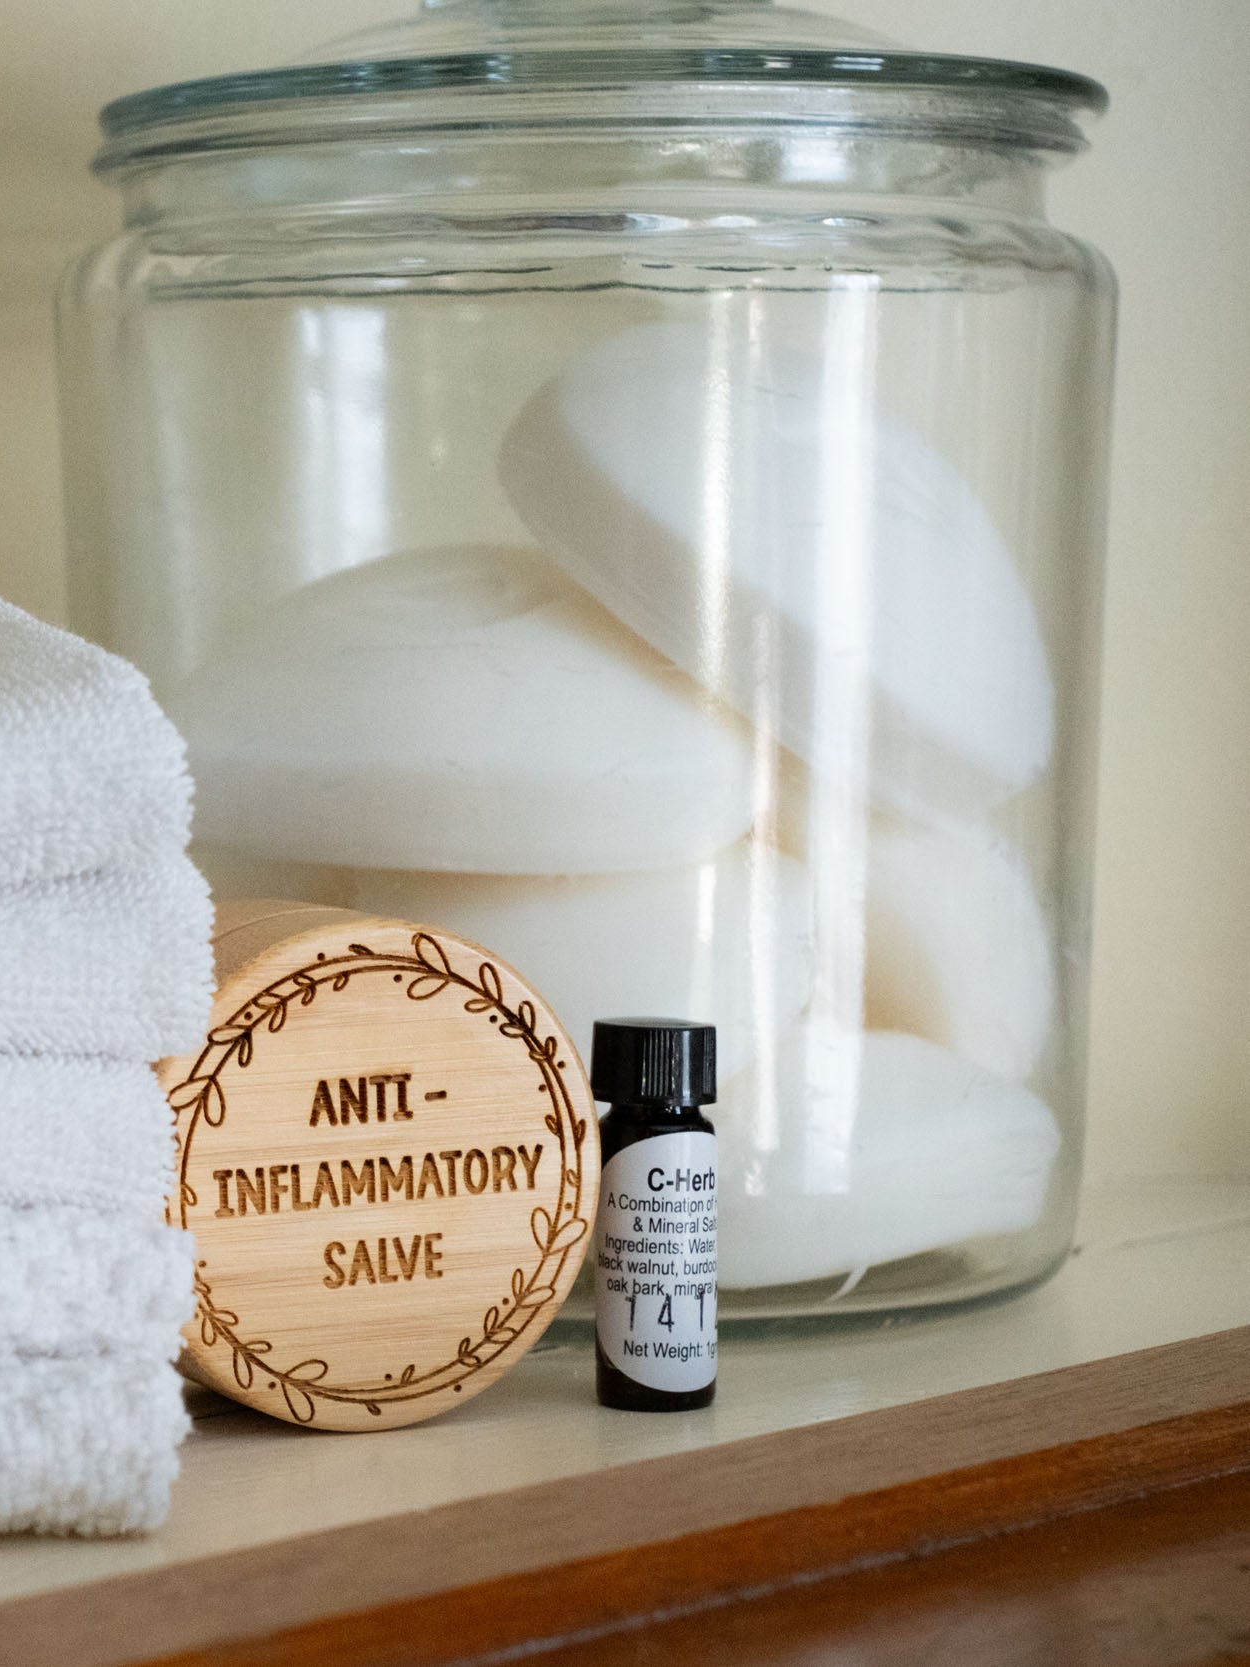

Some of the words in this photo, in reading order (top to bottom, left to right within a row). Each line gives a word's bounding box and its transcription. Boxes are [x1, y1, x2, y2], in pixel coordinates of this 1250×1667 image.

[309, 1073, 414, 1127] ANTI
[213, 1143, 544, 1218] INFLAMMATORY
[647, 1166, 716, 1192] C-Herb
[607, 1191, 616, 1208] A
[618, 1193, 704, 1213] Combination
[706, 1195, 714, 1211] of
[633, 1216, 643, 1232] &
[649, 1217, 699, 1234] Mineral
[605, 1233, 684, 1255] Ingredients:
[322, 1232, 444, 1289] SALVE
[598, 1250, 623, 1272] black
[627, 1259, 678, 1278] walnut,
[607, 1277, 628, 1293] oak
[674, 1280, 714, 1296] mineral
[624, 1339, 648, 1357] Net
[653, 1342, 703, 1362] Weight:
